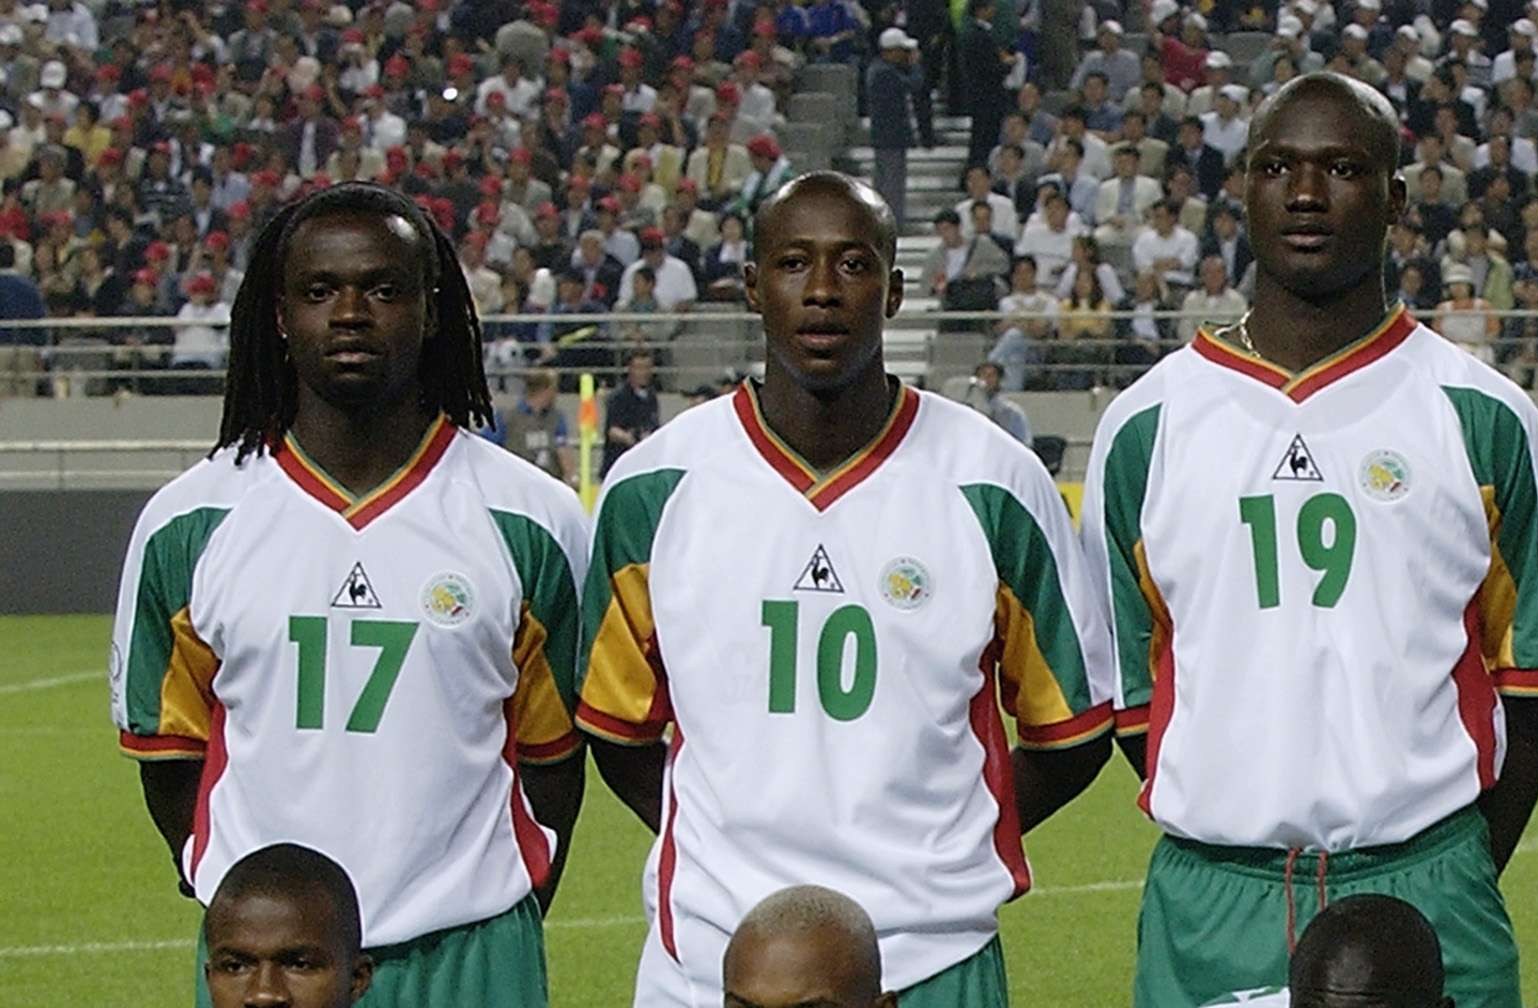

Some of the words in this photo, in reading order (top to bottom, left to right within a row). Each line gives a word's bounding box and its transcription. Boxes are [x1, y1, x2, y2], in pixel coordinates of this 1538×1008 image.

[1240, 493, 1356, 608] 19
[288, 616, 420, 733] 17
[762, 601, 877, 721] 10
